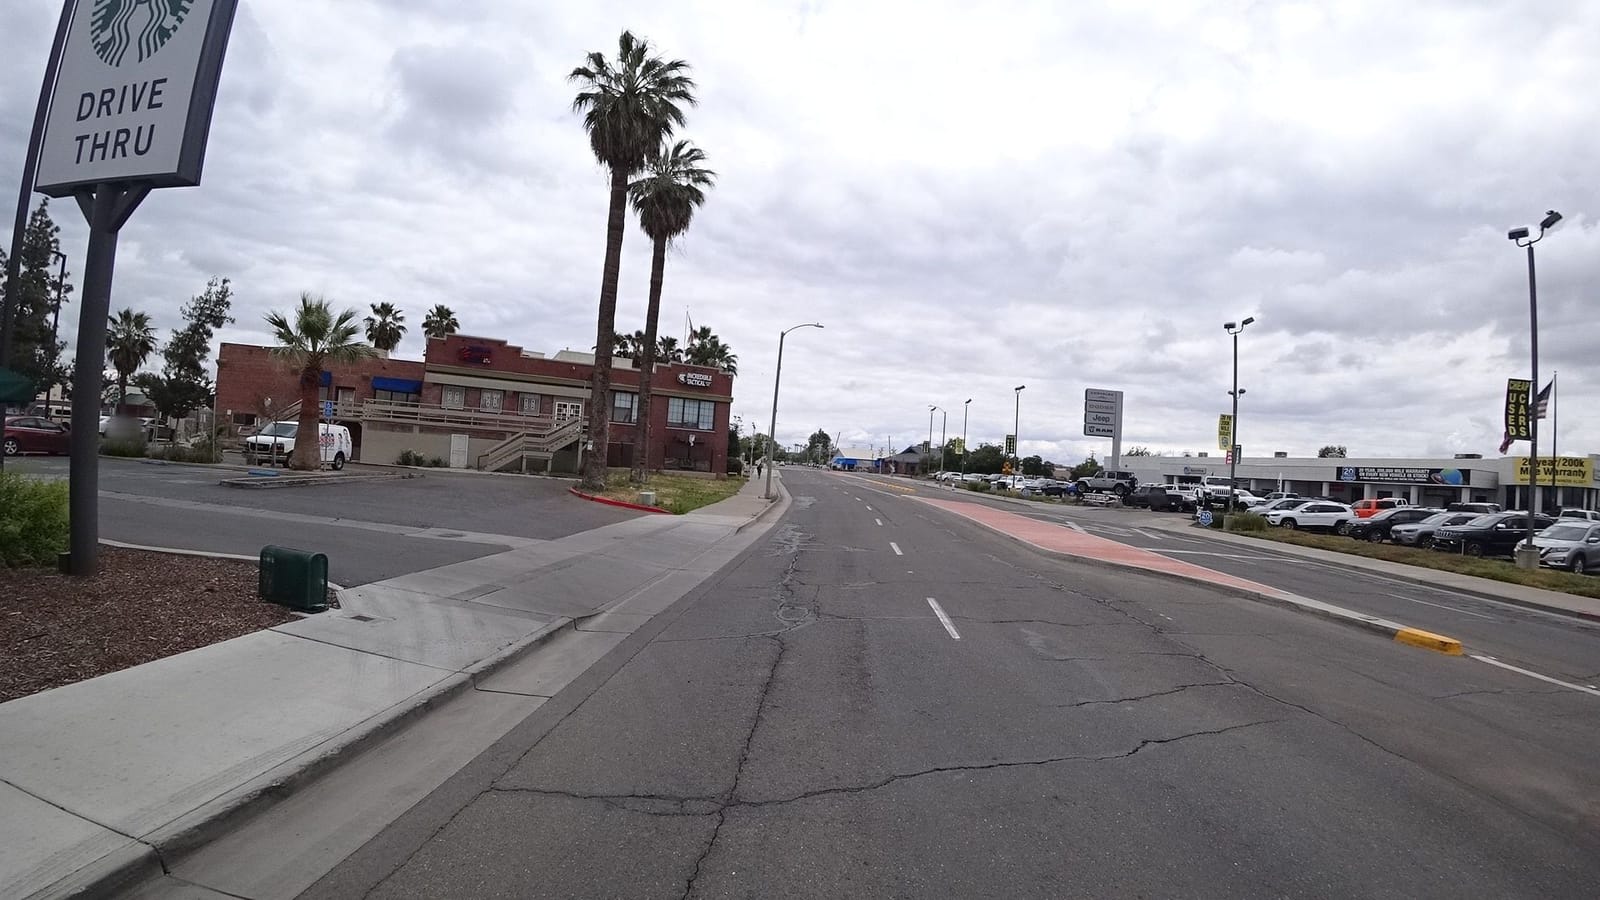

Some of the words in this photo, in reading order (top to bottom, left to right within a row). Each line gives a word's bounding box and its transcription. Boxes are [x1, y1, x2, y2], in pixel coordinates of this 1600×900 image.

[76, 78, 168, 122] DRIVE
[75, 124, 156, 164] THRU
[687, 373, 712, 381] INCREDIBLE
[1092, 414, 1111, 423] Jeep
[1508, 393, 1517, 436] USED
[1519, 393, 1527, 437] CARS
[1520, 467, 1541, 476] Me
[1543, 468, 1586, 479] Warranty
